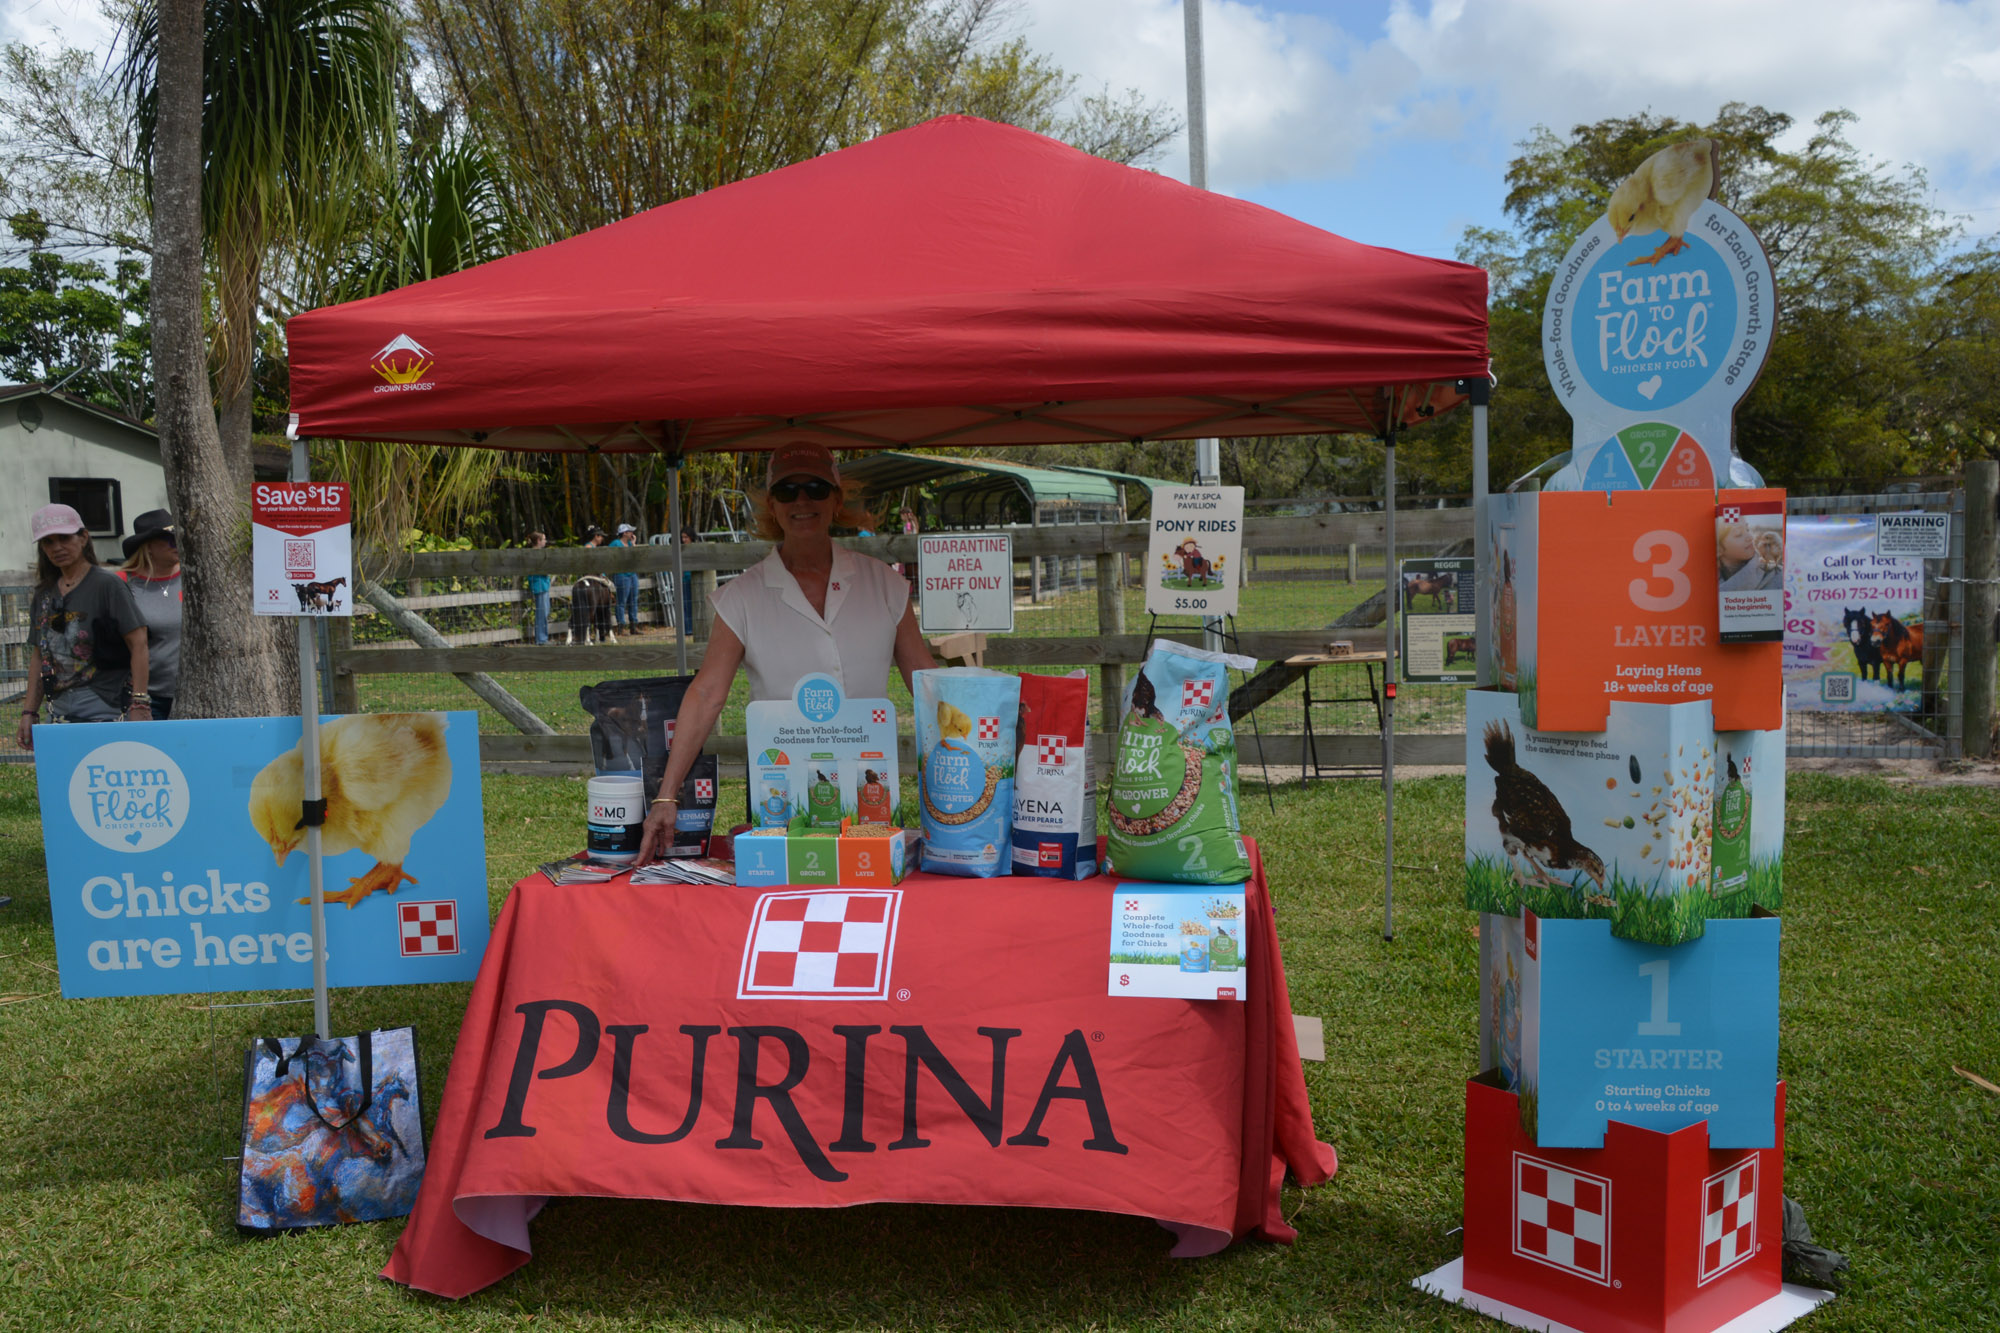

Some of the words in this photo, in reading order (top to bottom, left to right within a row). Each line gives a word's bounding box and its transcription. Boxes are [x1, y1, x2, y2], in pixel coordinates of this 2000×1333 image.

[1705, 214, 1727, 237] for
[1723, 231, 1753, 271] Each
[1555, 236, 1601, 304] Goodness
[1597, 269, 1711, 308] Farm
[1746, 270, 1762, 335] Growth
[1649, 305, 1675, 321] TO
[1595, 302, 1709, 372] Flock
[1549, 308, 1577, 398] Whole-food
[1612, 362, 1662, 374] CHICKEN
[1666, 359, 1696, 370] FOOD
[1725, 340, 1757, 385] Stage
[374, 385, 401, 393] CROWN
[1630, 430, 1667, 439] GROWER
[1638, 441, 1656, 468] 2
[1676, 448, 1696, 475] 3
[1603, 452, 1617, 478] 1
[1591, 481, 1628, 489] STARTER
[1672, 479, 1699, 487] LAYER
[256, 485, 307, 505] Save
[1156, 520, 1195, 532] PONY
[1198, 520, 1236, 532] RIDES
[1882, 517, 1945, 527] WARNING
[923, 538, 1007, 554] QUARANTINE
[947, 558, 983, 572] AREA
[1824, 555, 1848, 567] Call
[1851, 558, 1866, 566] or
[1869, 555, 1896, 566] Text
[1628, 529, 1692, 612] 3
[1807, 573, 1819, 582] to
[1821, 570, 1850, 581] Book
[1852, 570, 1879, 580] Your
[1883, 570, 1918, 583] Party!
[926, 577, 965, 590] STAFF
[968, 576, 1001, 590] ONLY
[1753, 596, 1767, 604] just
[1808, 588, 1846, 602] (786)
[1849, 587, 1918, 600] 752-0111
[1175, 597, 1207, 609] $5.00
[1737, 603, 1772, 611] beginning
[1614, 625, 1706, 647] LAYER
[1615, 664, 1664, 679] Laying
[1667, 665, 1702, 676] Hens
[804, 688, 833, 697] Farm
[1604, 681, 1625, 693] 18+
[1627, 680, 1669, 693] weeks
[1671, 680, 1686, 693] of
[1688, 683, 1713, 695] age
[804, 697, 834, 712] Flock
[779, 727, 795, 735] See
[811, 726, 863, 735] Whole-food
[773, 736, 815, 744] Goodness
[817, 736, 830, 744] for
[831, 735, 870, 744] Yourself!
[1525, 734, 1532, 742] A
[1532, 735, 1561, 746] yummy
[1563, 738, 1580, 747] way
[1591, 740, 1608, 749] feed
[935, 751, 969, 766] Farm
[1131, 749, 1145, 757] TO
[1525, 744, 1537, 752] the
[1539, 746, 1575, 757] awkward
[1577, 750, 1594, 758] teen
[1595, 751, 1620, 760] phase
[86, 765, 171, 788] Farm
[934, 765, 969, 790] Flock
[1037, 767, 1064, 777] PURINA
[127, 789, 146, 799] TO
[1122, 788, 1169, 800] GROWER
[87, 788, 173, 828] Flock
[604, 807, 626, 819] MQ
[1012, 799, 1064, 814] AYENA
[1037, 816, 1063, 824] PEARLS
[1178, 835, 1208, 870] 2
[1739, 839, 1747, 860] 2
[755, 851, 766, 868] 1
[805, 851, 819, 869] 2
[858, 851, 871, 869] 3
[81, 869, 271, 919] Chicks
[1123, 922, 1174, 930] Whole-food
[1122, 931, 1165, 939] Goodness
[87, 936, 182, 971] are
[190, 917, 329, 967] here
[1120, 974, 1130, 986] $
[1637, 959, 1681, 1036] 1
[1594, 1049, 1723, 1070] STARTER
[484, 999, 1129, 1183] PURINA
[1605, 1085, 1662, 1098] Starting
[1665, 1084, 1710, 1097] Chicks
[1595, 1101, 1605, 1112] 0
[1607, 1102, 1622, 1112] to
[1624, 1101, 1632, 1112] 4
[1635, 1101, 1676, 1112] weeks
[1678, 1101, 1693, 1112] of
[1694, 1103, 1719, 1114] age
